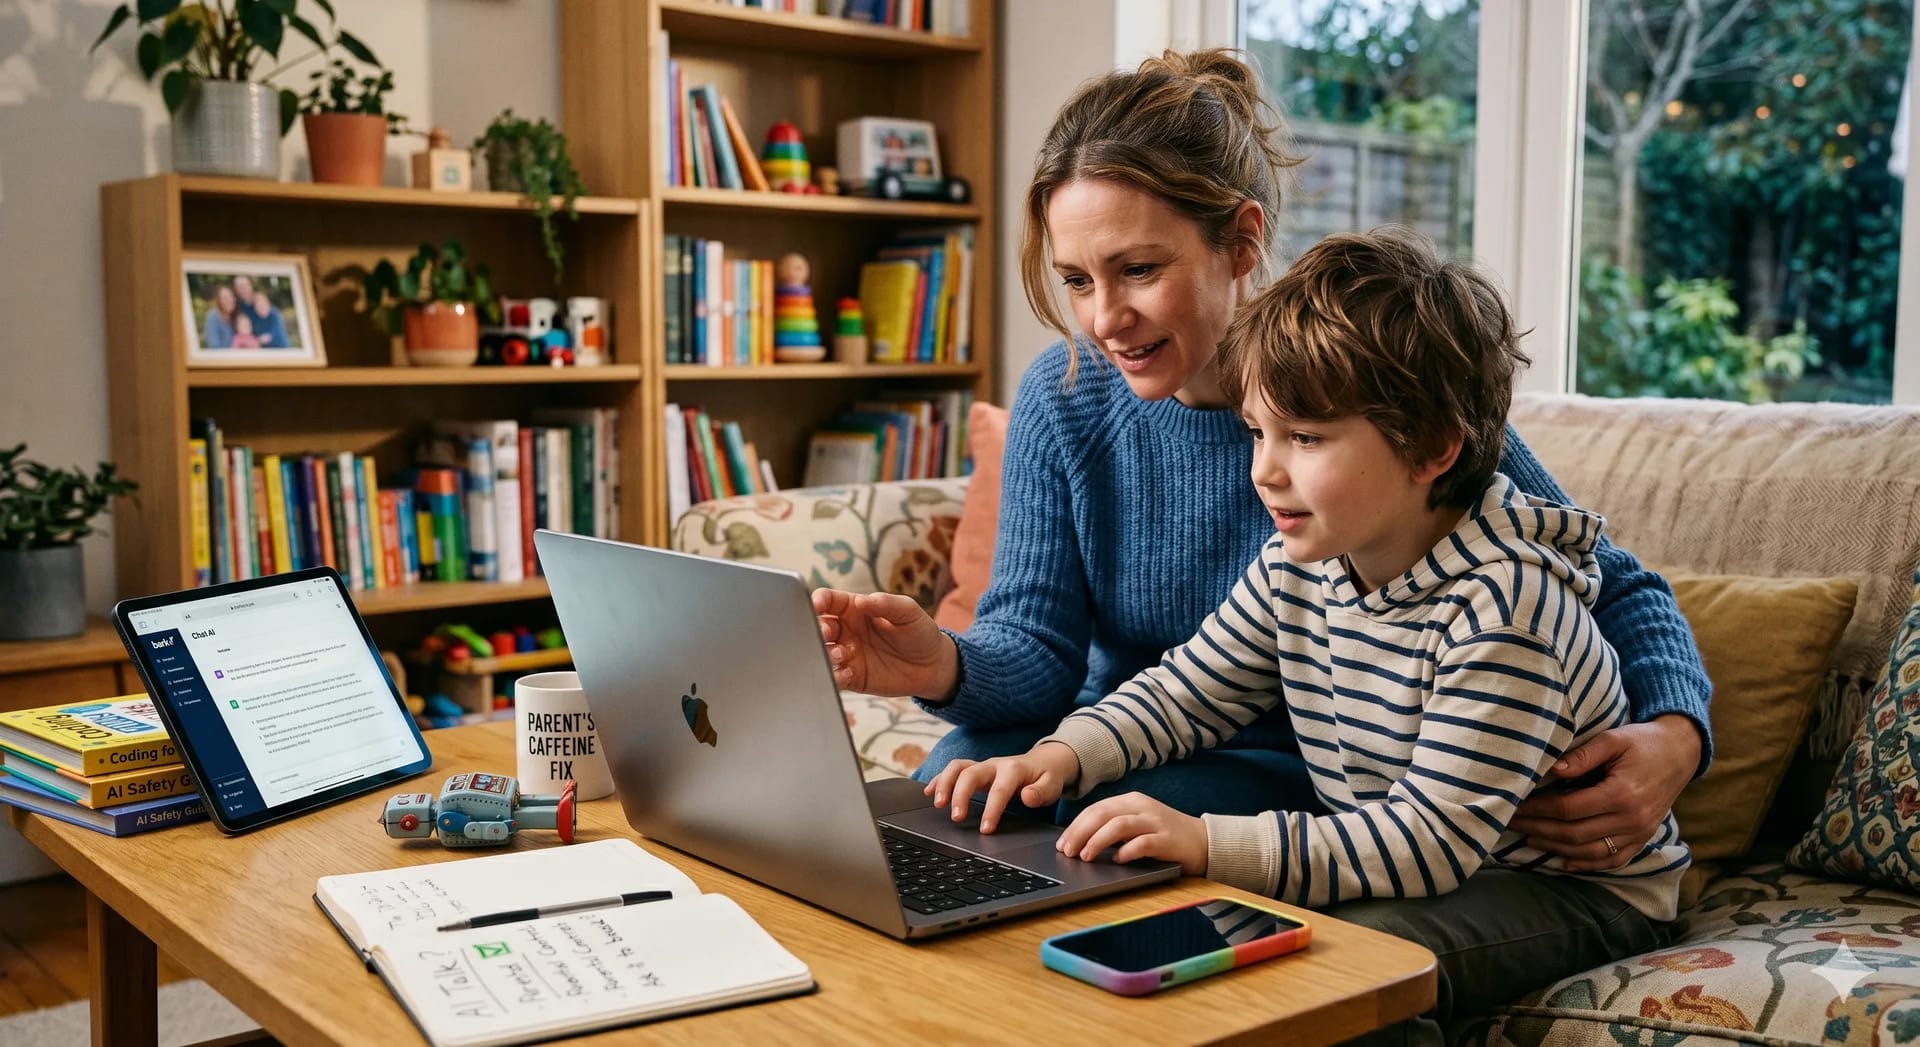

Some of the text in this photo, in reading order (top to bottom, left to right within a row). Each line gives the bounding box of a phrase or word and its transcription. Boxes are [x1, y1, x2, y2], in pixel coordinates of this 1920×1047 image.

[37, 714, 112, 740] Coding
[528, 712, 595, 733] PARENT'S
[110, 748, 158, 764] Coding
[529, 735, 595, 756] CAFFEINE
[550, 761, 574, 780] FIX
[107, 785, 123, 800] AI
[127, 778, 177, 796] Safety
[136, 815, 148, 827] AI
[149, 808, 182, 824] Safety
